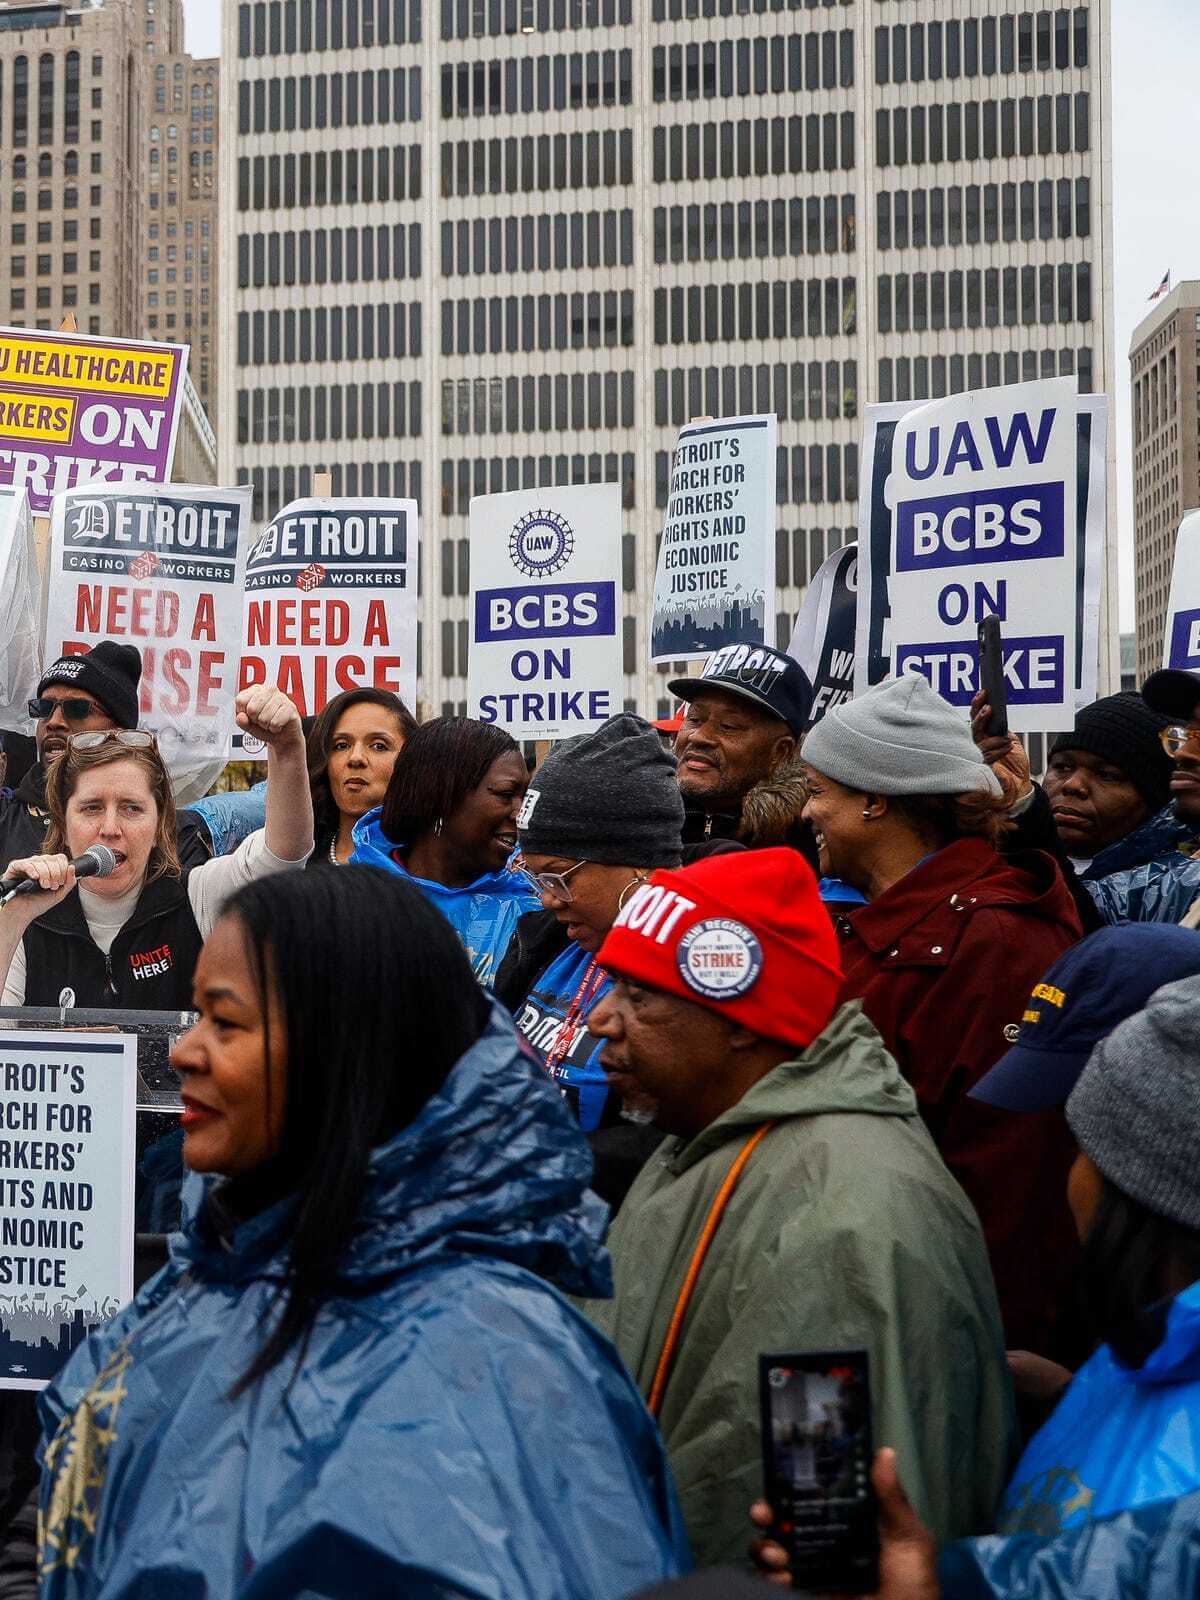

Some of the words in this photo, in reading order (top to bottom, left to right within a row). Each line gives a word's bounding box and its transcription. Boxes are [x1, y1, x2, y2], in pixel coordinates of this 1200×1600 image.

[15, 349, 168, 388] HEALTHCARE
[79, 404, 166, 450] ON
[905, 407, 1057, 481] UAW
[714, 464, 745, 485] FOR
[71, 499, 232, 549] DETROIT
[247, 517, 399, 564] DETROIT
[664, 521, 709, 545] RIGHTS
[713, 515, 746, 536] AND
[913, 499, 1042, 557] BCBS
[526, 535, 554, 551] UAW
[665, 541, 739, 569] ECONOMIC
[69, 557, 125, 570] CASINO
[163, 564, 231, 578] WORKERS
[245, 574, 291, 587] CASINO
[330, 574, 401, 584] WORKERS
[670, 569, 728, 593] JUSTICE
[75, 584, 180, 638] NEED
[191, 593, 217, 642] A
[490, 592, 598, 632] BCBS
[937, 579, 1007, 626] ON
[247, 600, 350, 647] NEED
[363, 600, 389, 647] A
[511, 648, 571, 682] ON
[901, 648, 1056, 693] STRKE
[479, 690, 610, 723] STRIKE
[705, 920, 753, 940] REGION
[130, 944, 171, 967] UNITE
[692, 953, 745, 967] STRIKE
[46, 1104, 92, 1133] FOR
[42, 1181, 93, 1211] AND
